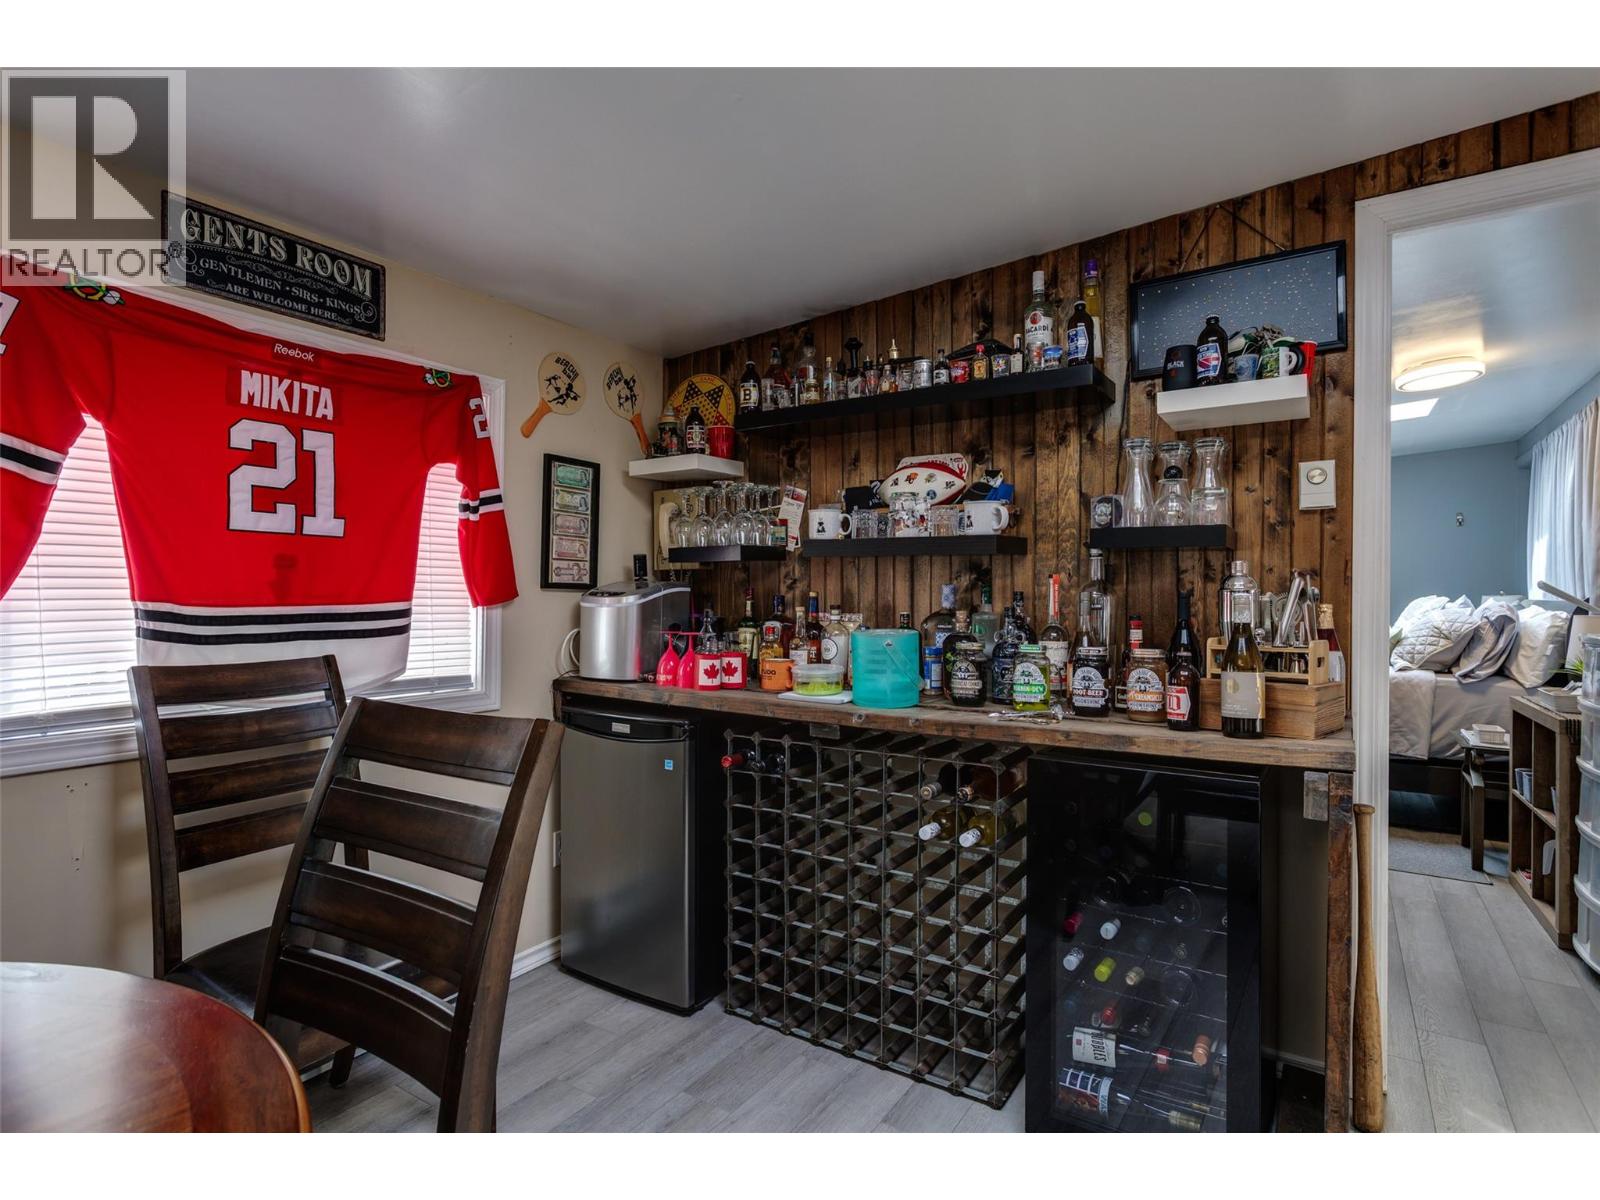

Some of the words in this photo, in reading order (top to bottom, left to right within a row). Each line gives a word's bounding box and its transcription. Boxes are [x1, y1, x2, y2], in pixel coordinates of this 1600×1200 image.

[181, 208, 287, 263] GENTS
[296, 244, 373, 299] ROOM
[200, 258, 282, 291] GENTLEMEN
[291, 287, 319, 304] SIRS
[326, 297, 361, 315] KINGS
[225, 282, 249, 297] ARE
[252, 290, 309, 314] WELCOME
[310, 307, 338, 321] HERE
[274, 343, 315, 363] Reebok
[240, 370, 334, 421] MIKITA
[743, 388, 752, 401] B
[228, 418, 346, 538] 21
